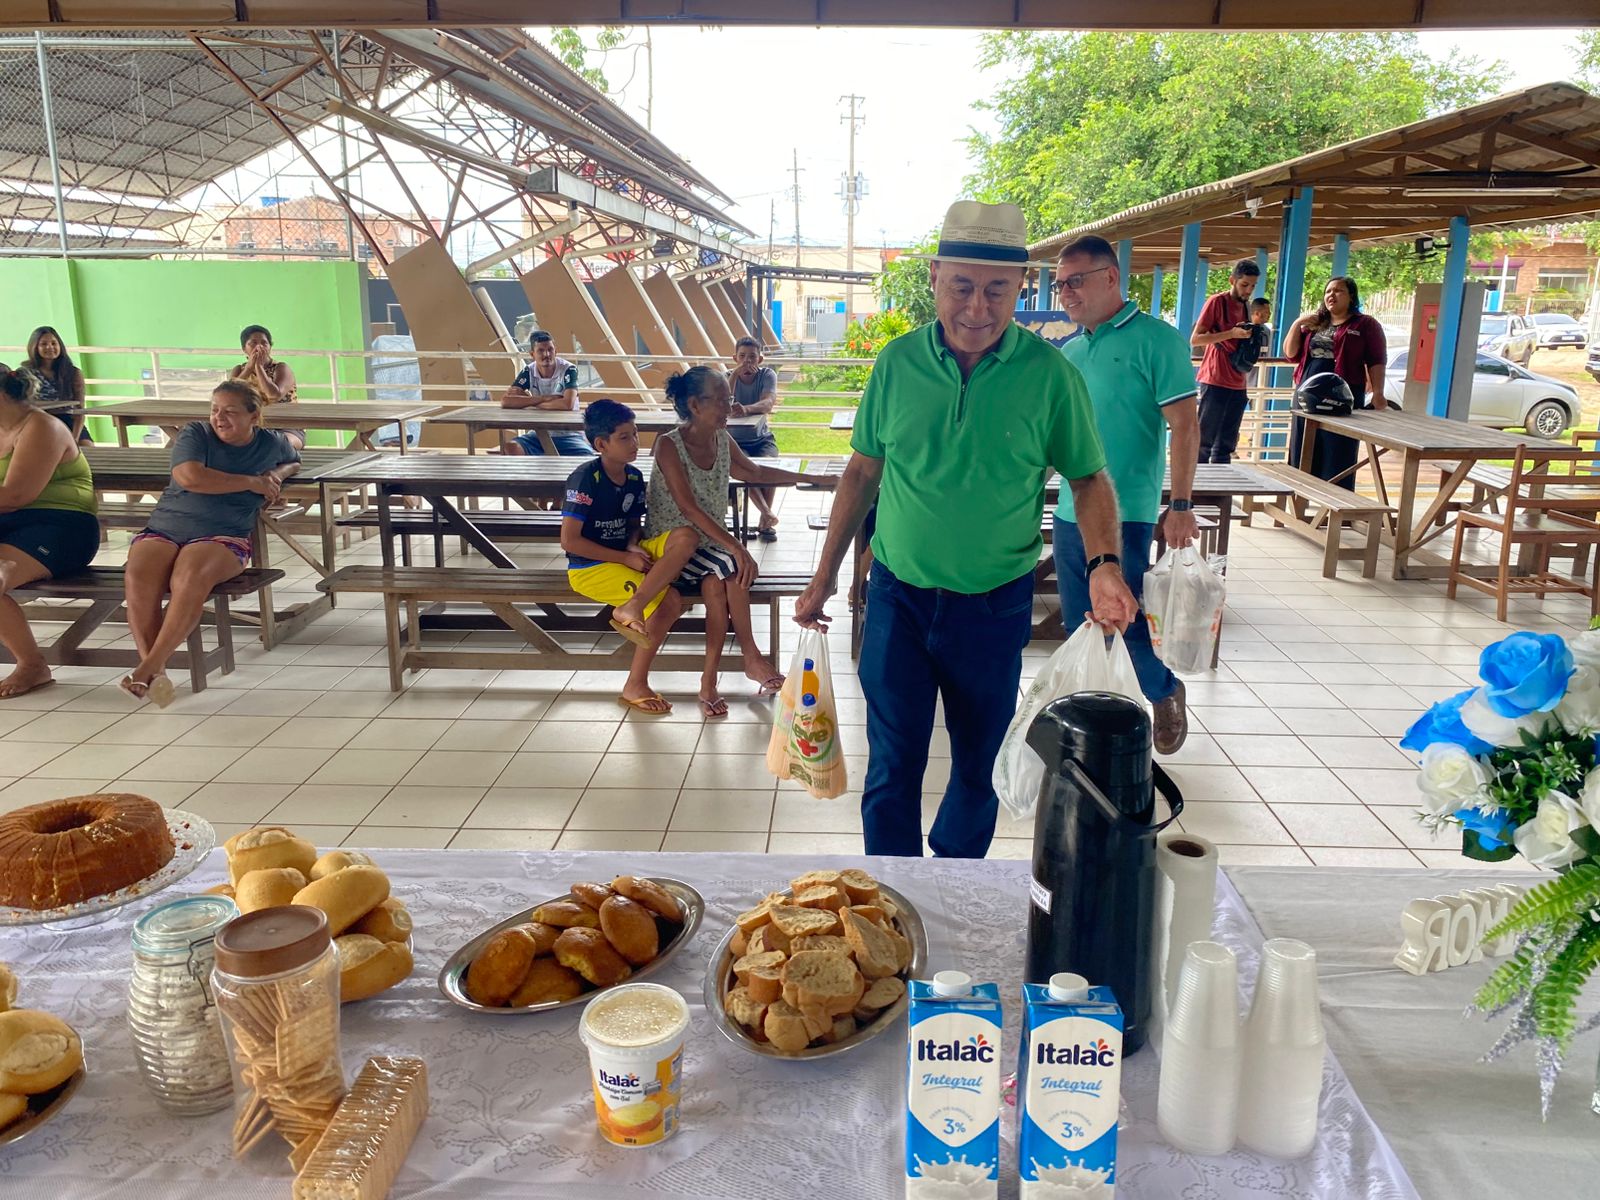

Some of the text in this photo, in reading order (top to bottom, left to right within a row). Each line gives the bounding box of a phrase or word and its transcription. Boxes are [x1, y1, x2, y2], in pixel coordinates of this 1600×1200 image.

[918, 1039, 994, 1063] Italac
[1037, 1042, 1114, 1067] Italac
[599, 1069, 640, 1088] Italac
[922, 1073, 982, 1090] Integral
[1040, 1077, 1103, 1093] Integral
[943, 1118, 966, 1135] 3%
[1060, 1122, 1084, 1139] 3%
